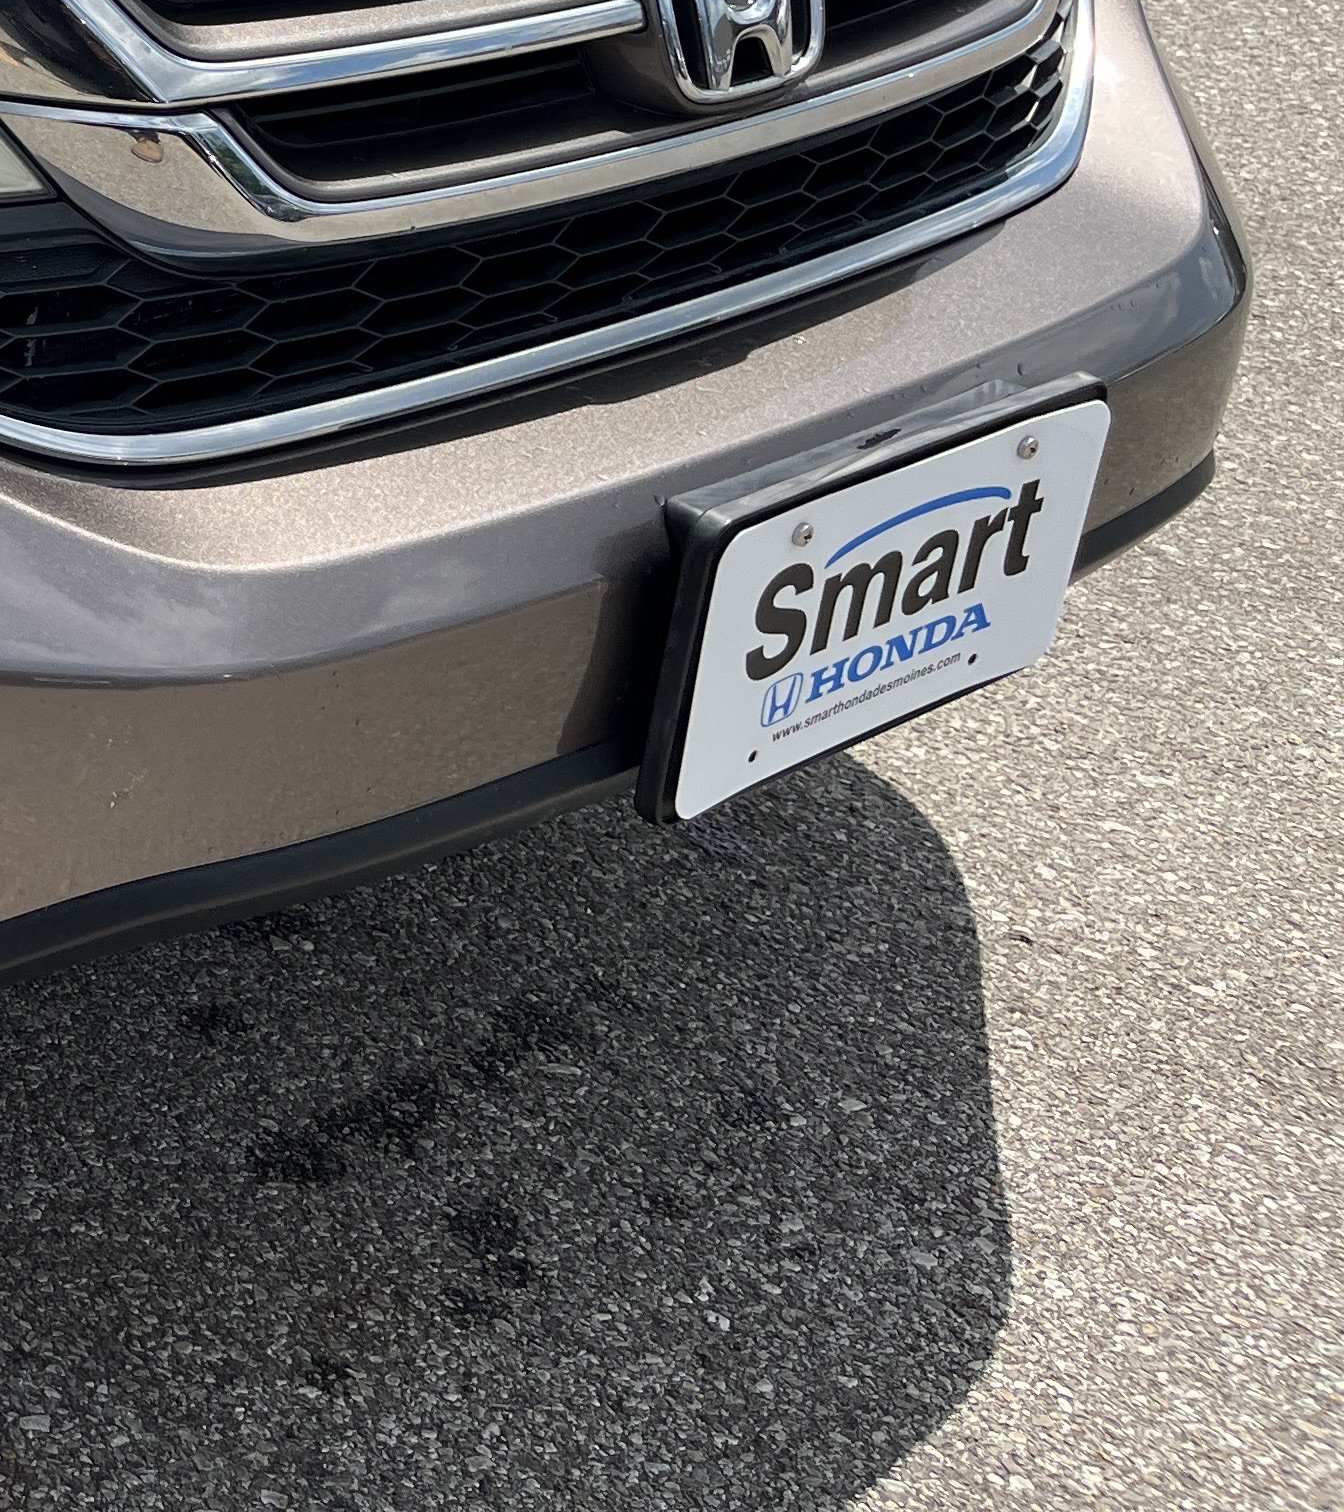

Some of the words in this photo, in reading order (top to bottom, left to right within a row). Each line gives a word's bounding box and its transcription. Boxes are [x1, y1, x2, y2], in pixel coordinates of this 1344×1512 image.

[745, 479, 1043, 681] Smart
[772, 651, 961, 743] www.smarthondadesmoines.com
[805, 603, 990, 703] HONDA
